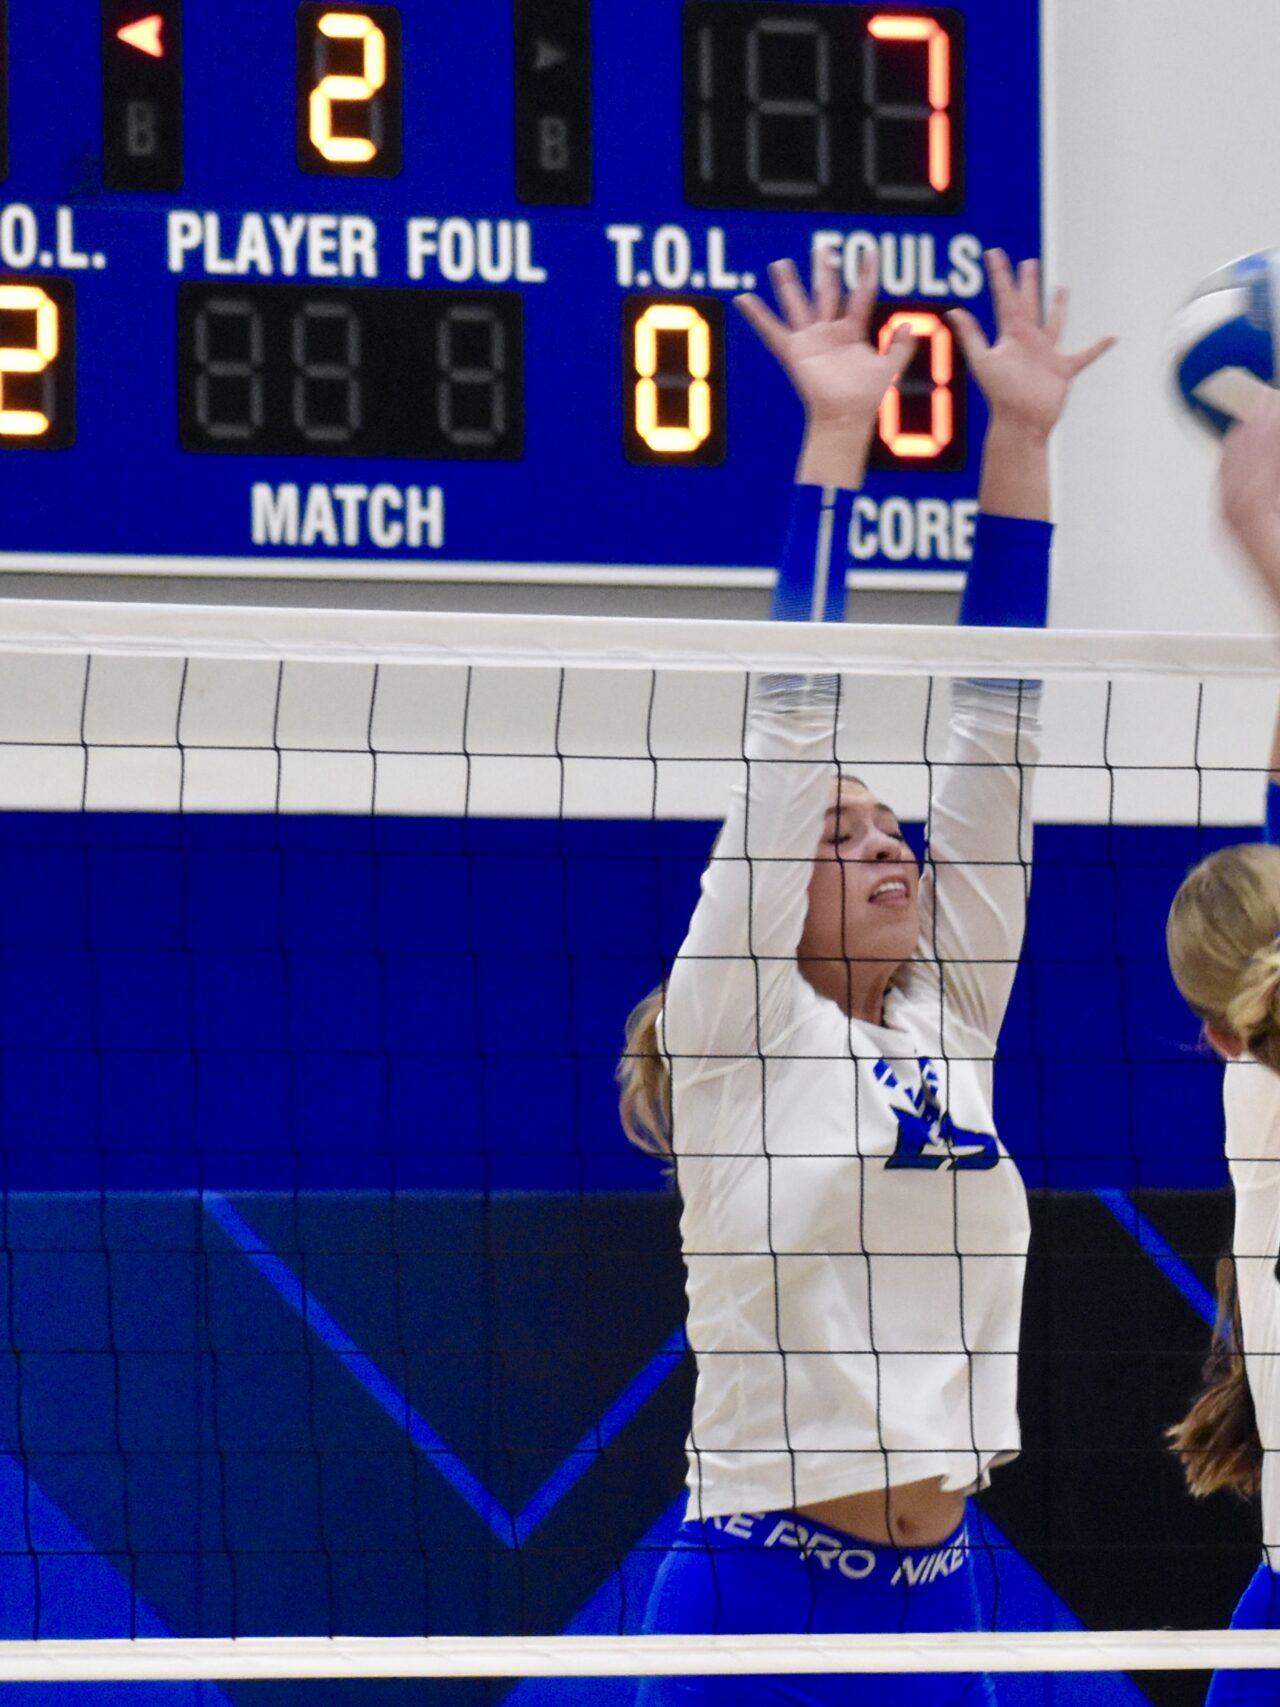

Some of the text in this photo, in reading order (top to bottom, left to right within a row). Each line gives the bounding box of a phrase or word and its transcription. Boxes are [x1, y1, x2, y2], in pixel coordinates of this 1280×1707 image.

[308, 12, 387, 162] 2
[0, 203, 107, 270] O.L.
[167, 210, 548, 283] PLAYER FOUL
[606, 224, 757, 290] T.O.L.
[634, 304, 711, 453] 0
[877, 310, 953, 459] 0
[251, 482, 444, 549] MATCH
[848, 496, 980, 561] CORE
[764, 1519, 877, 1580] PRO
[890, 1528, 967, 1587] NIKE
